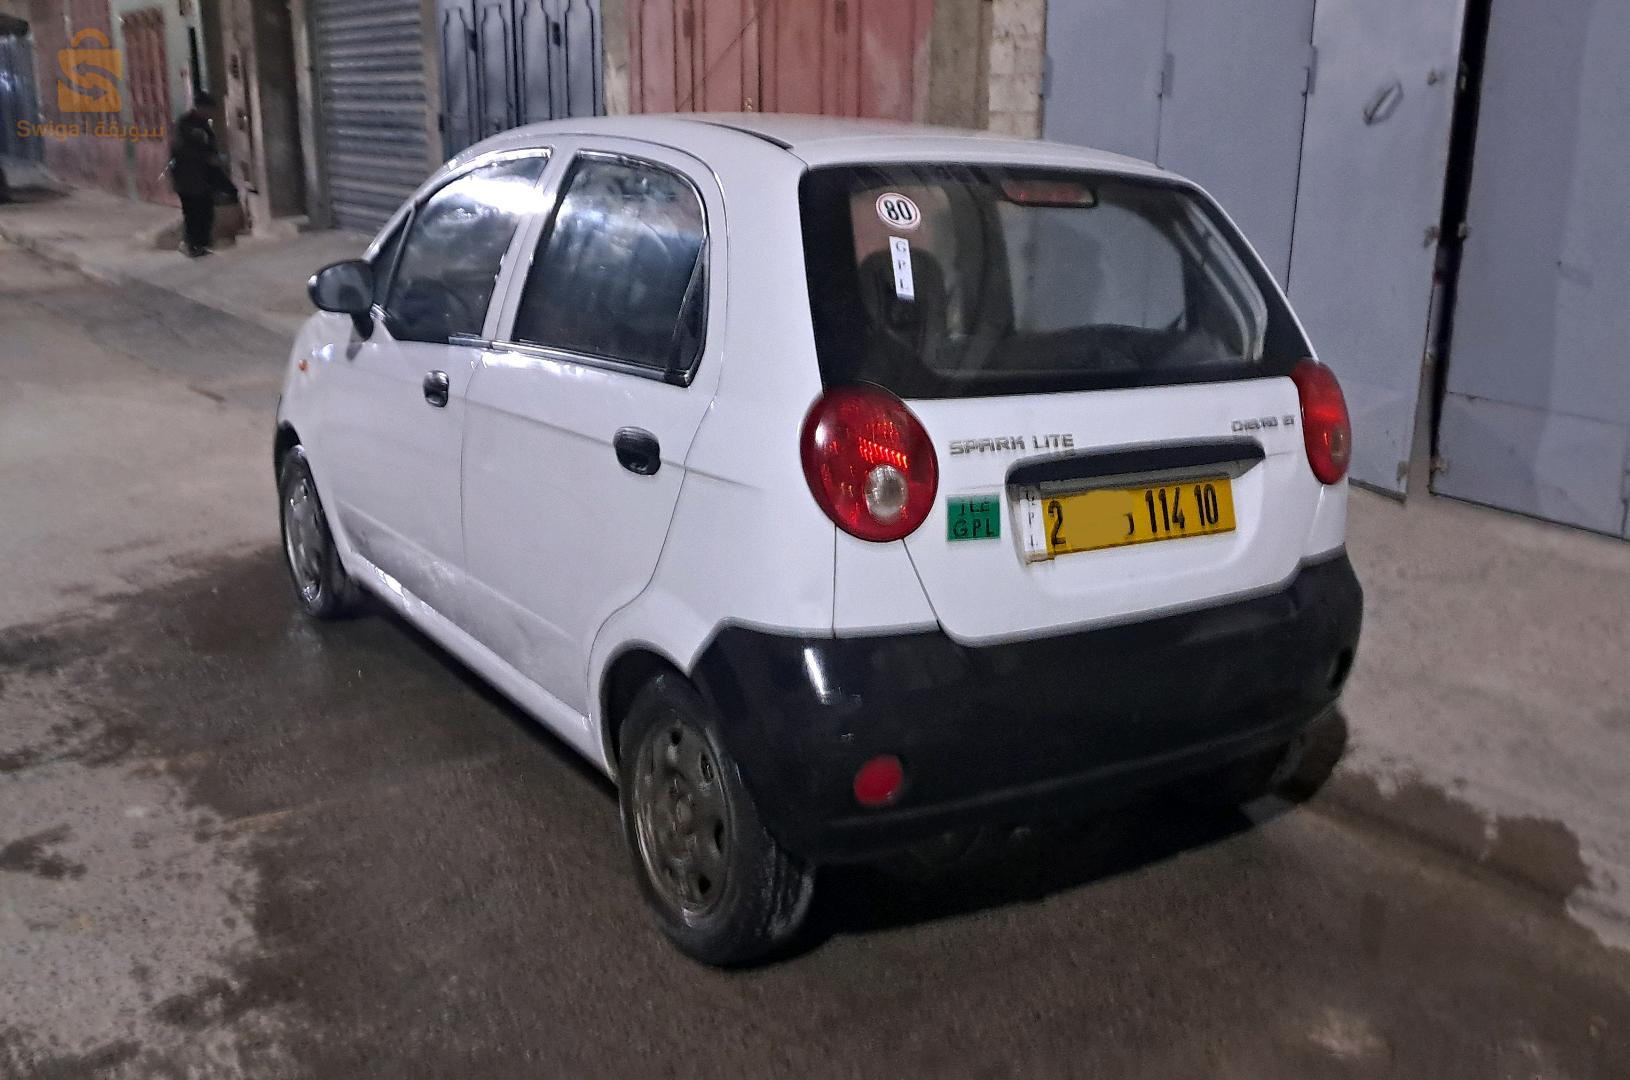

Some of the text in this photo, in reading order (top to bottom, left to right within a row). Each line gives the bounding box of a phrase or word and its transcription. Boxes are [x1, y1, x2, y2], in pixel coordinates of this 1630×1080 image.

[884, 200, 912, 221] 80
[896, 241, 908, 289] GPL
[950, 434, 1074, 455] SPARK LITE
[1145, 487, 1185, 533] 114
[1194, 484, 1218, 526] 10
[953, 519, 994, 537] GPL
